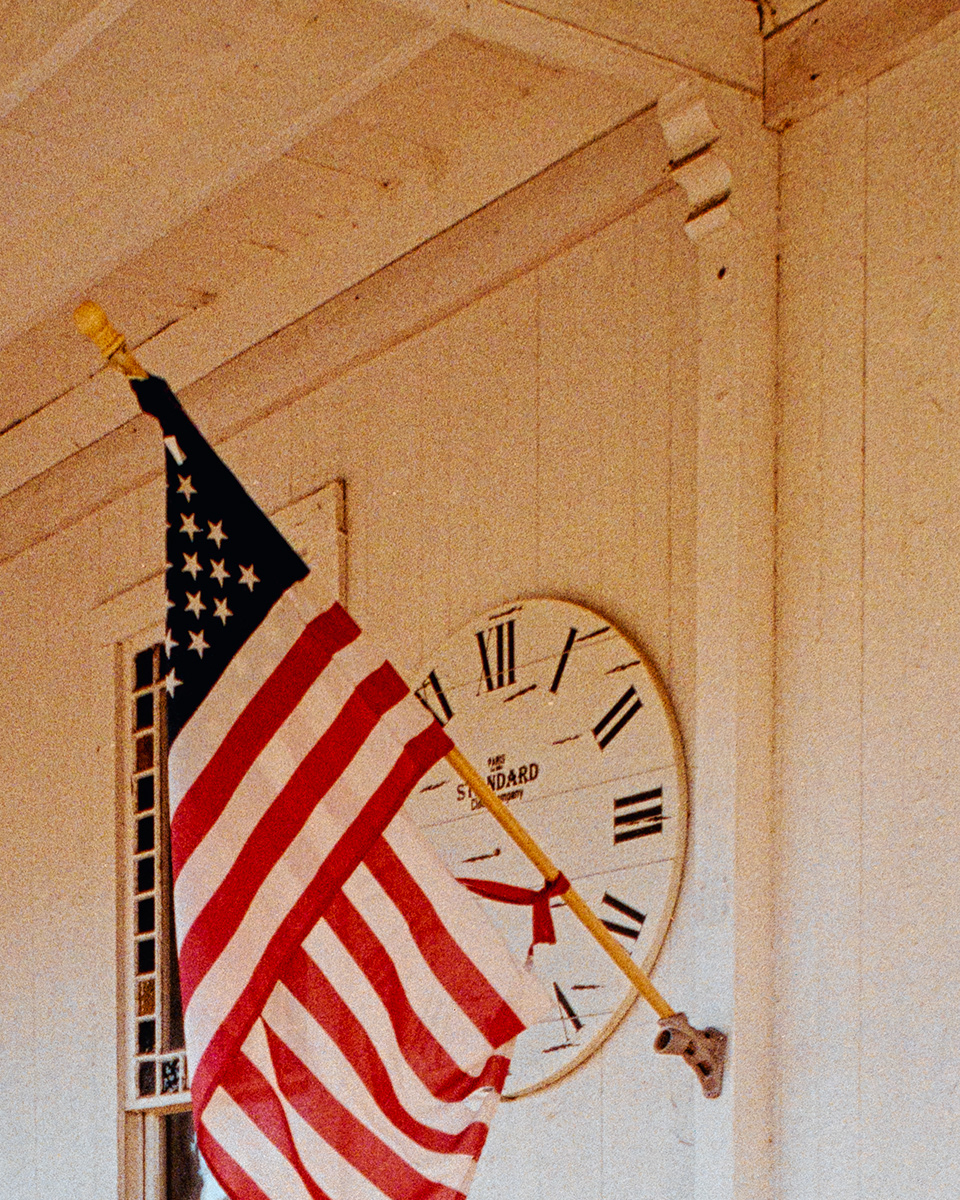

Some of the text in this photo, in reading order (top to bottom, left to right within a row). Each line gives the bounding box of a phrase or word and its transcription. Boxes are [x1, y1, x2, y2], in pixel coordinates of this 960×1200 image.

[475, 619, 516, 697] XII
[591, 684, 643, 751] II
[456, 762, 539, 802] STNDARD
[614, 784, 663, 845] III
